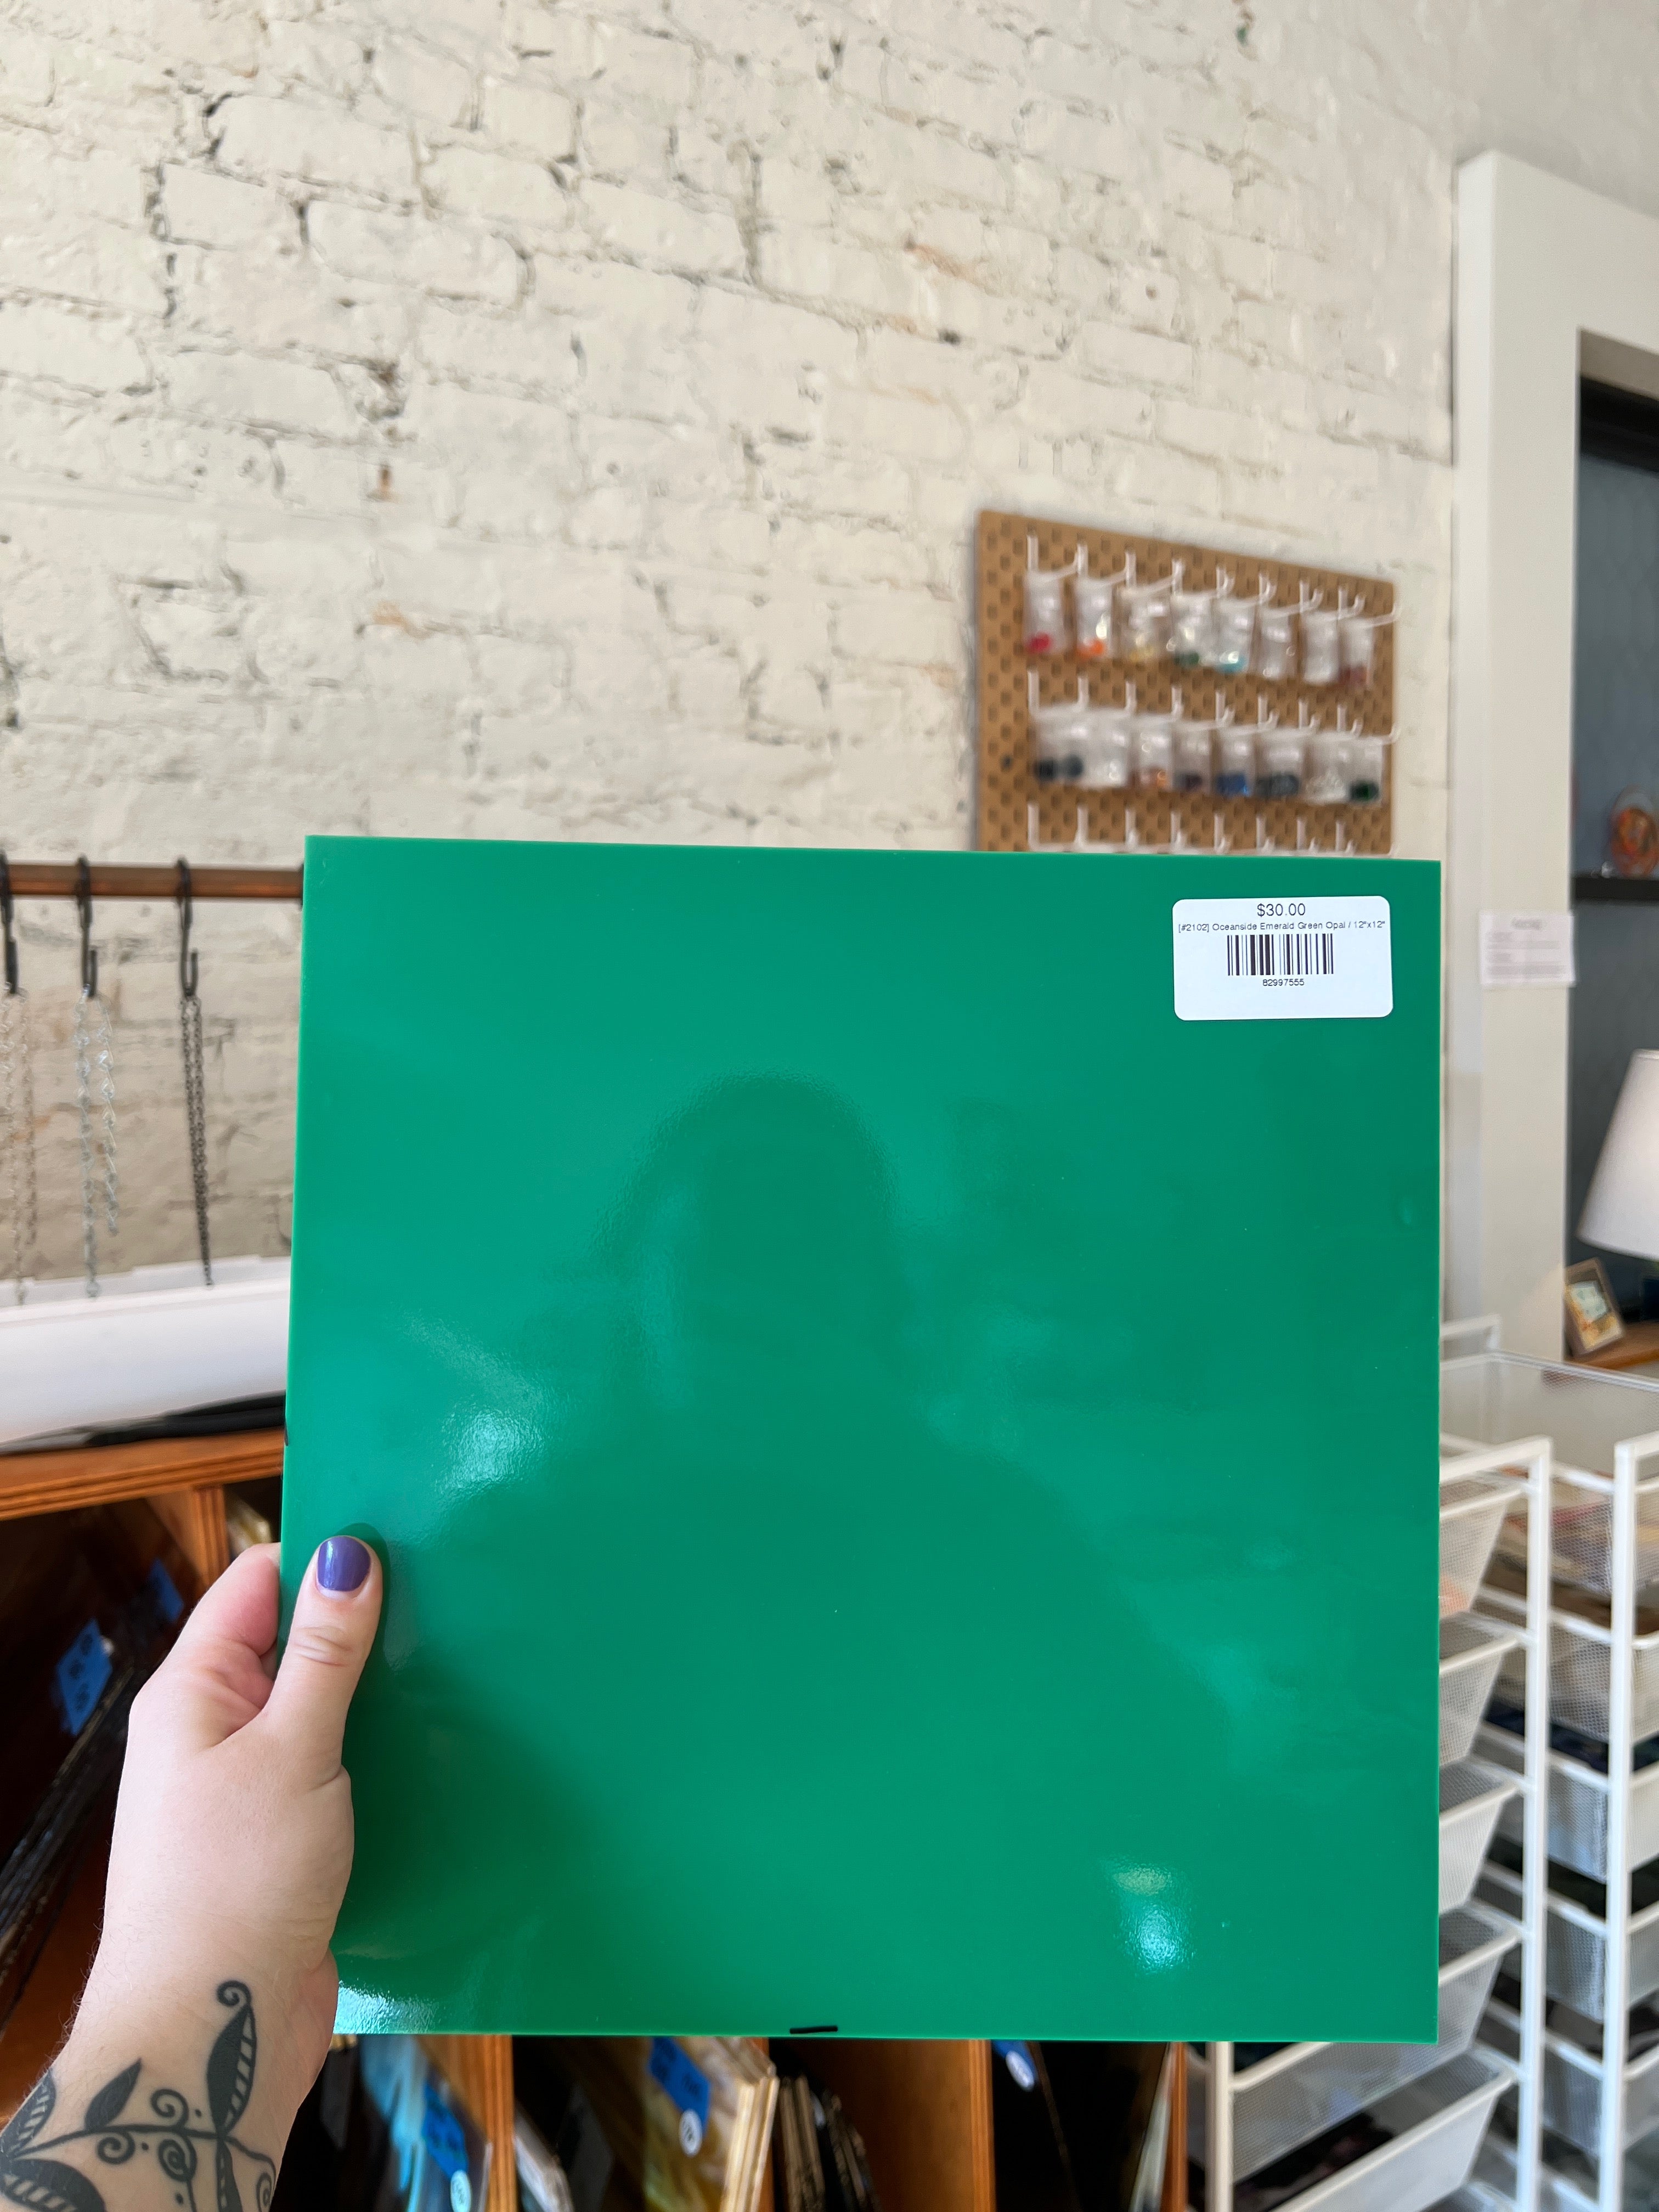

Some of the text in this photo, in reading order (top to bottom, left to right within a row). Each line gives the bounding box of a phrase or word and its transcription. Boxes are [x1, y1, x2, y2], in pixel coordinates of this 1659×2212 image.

[1257, 903, 1306, 917] $30.00
[1178, 923, 1209, 933] [#2102]
[1325, 921, 1346, 930] Opal
[1262, 978, 1305, 986] 82997555
